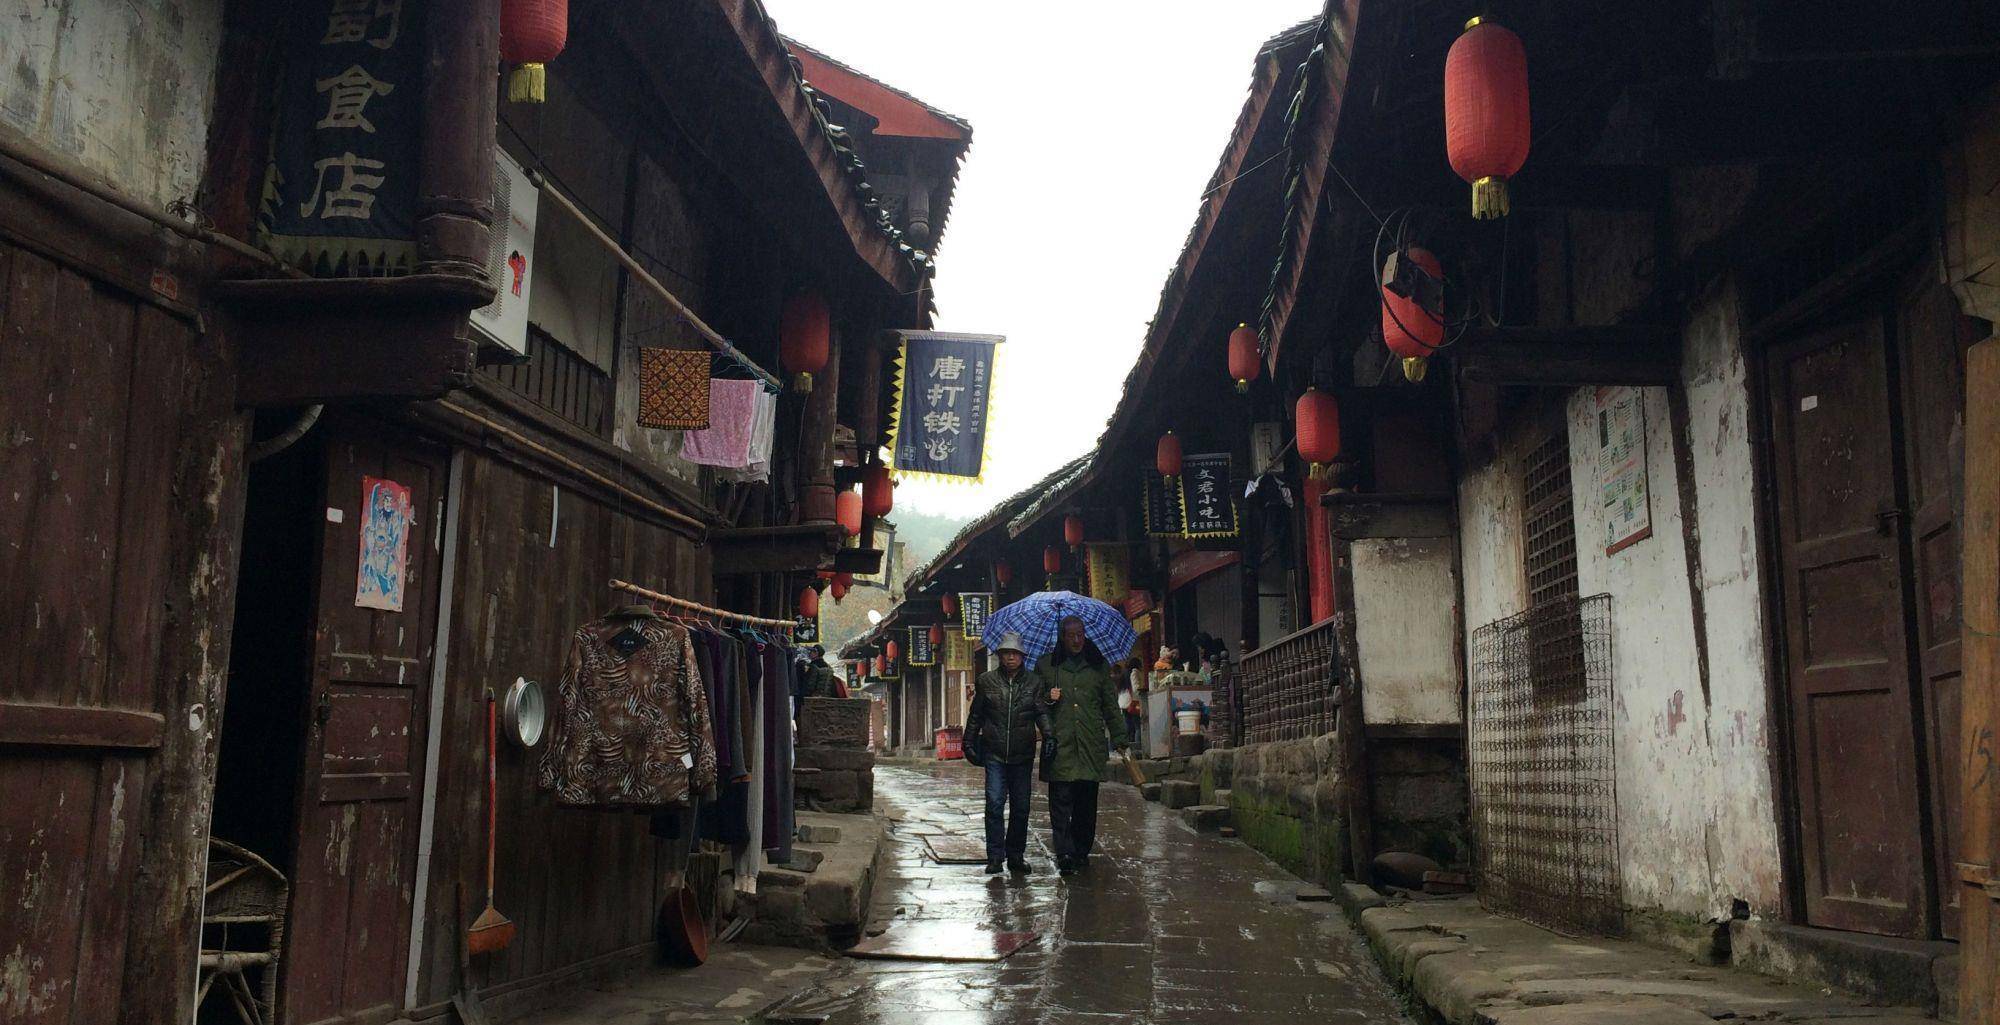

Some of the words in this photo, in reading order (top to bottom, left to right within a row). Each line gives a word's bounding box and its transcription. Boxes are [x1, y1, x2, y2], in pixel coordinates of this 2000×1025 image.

[300, 0, 402, 220] 副食店
[922, 355, 966, 436] 唐打铁
[1194, 468, 1221, 519] 文君小吃
